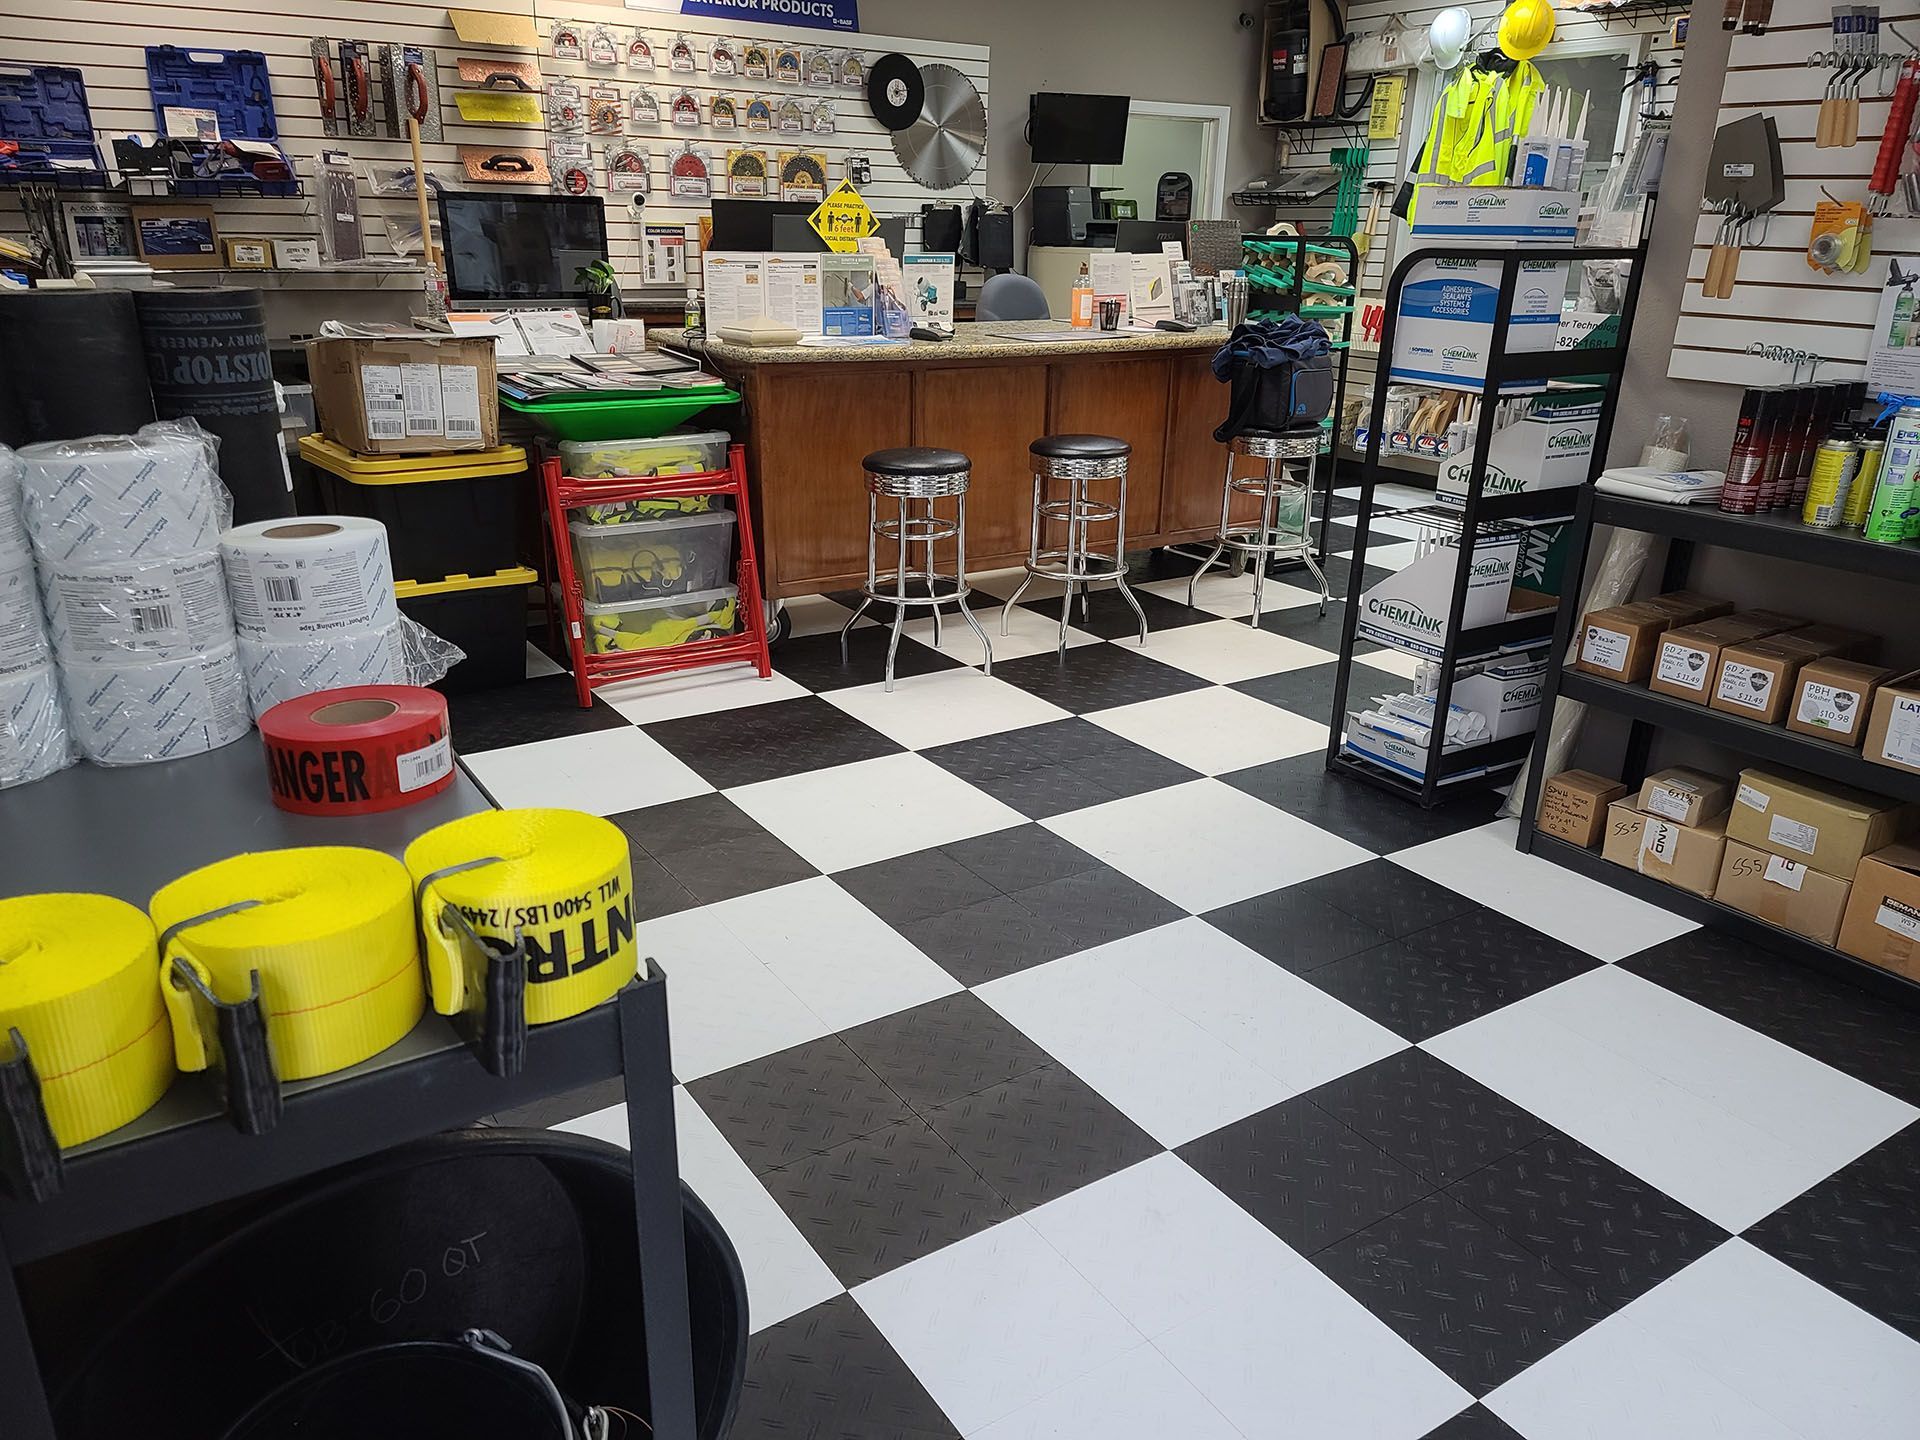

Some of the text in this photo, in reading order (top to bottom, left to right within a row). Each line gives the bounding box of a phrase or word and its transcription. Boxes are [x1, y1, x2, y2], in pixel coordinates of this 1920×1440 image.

[762, 0, 834, 18] PRODUCTS
[840, 224, 855, 233] feet
[1441, 285, 1473, 293] ADHESIVES
[1442, 293, 1472, 301] SEALANTS
[1431, 306, 1469, 316] ACCESSORIES
[1548, 433, 1593, 449] CHEMLINK
[1735, 432, 1748, 444] 77
[1368, 598, 1444, 633] CHEMLINK
[1664, 645, 1675, 653] 6D
[1725, 664, 1738, 673] 6D
[1724, 671, 1747, 682] Common
[1503, 687, 1543, 703] CHEMLIN
[1807, 692, 1832, 703] Washer
[1808, 685, 1831, 697] PBH
[1819, 709, 1850, 724] $10.98
[1383, 740, 1416, 757] CHEMLINK
[598, 875, 621, 901] WLL
[553, 890, 592, 920] 5400
[514, 904, 549, 927] LBS
[480, 893, 634, 984] NTR
